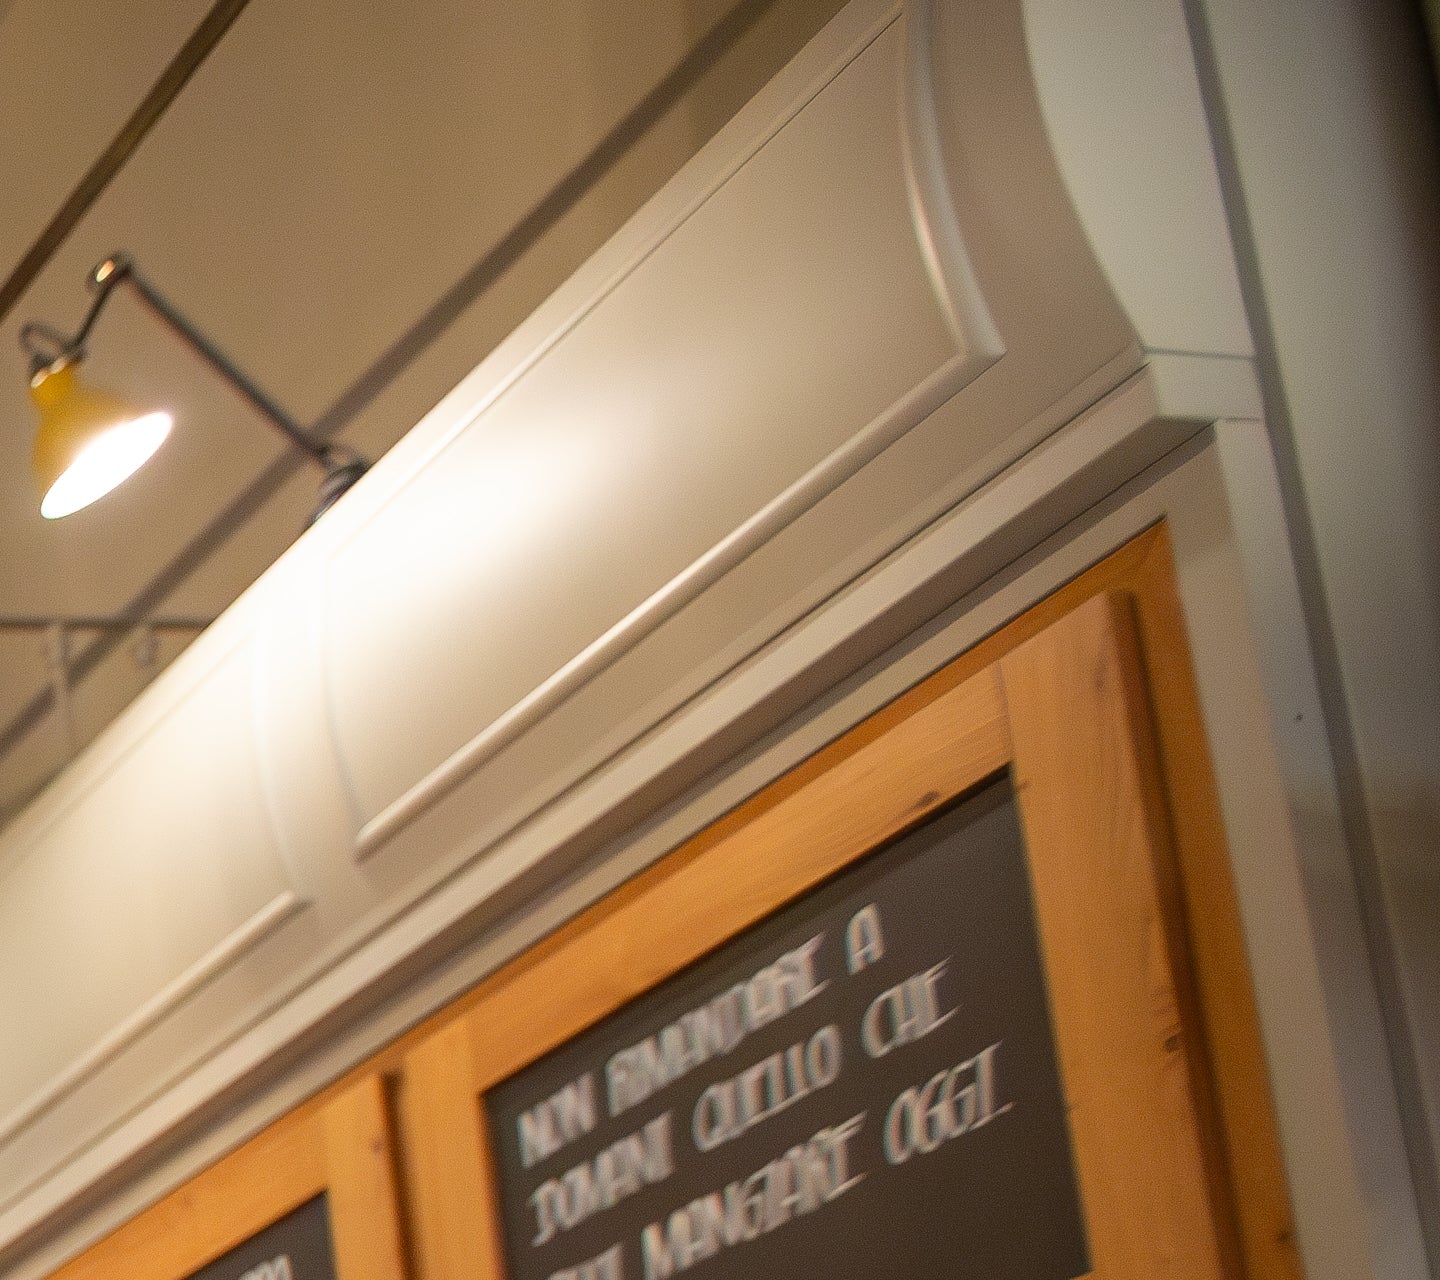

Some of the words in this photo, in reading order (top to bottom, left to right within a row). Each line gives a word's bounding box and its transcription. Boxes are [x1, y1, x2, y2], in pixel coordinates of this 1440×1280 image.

[844, 902, 884, 975] A
[692, 1023, 843, 1152] QUELLO
[861, 955, 963, 1059] CHE
